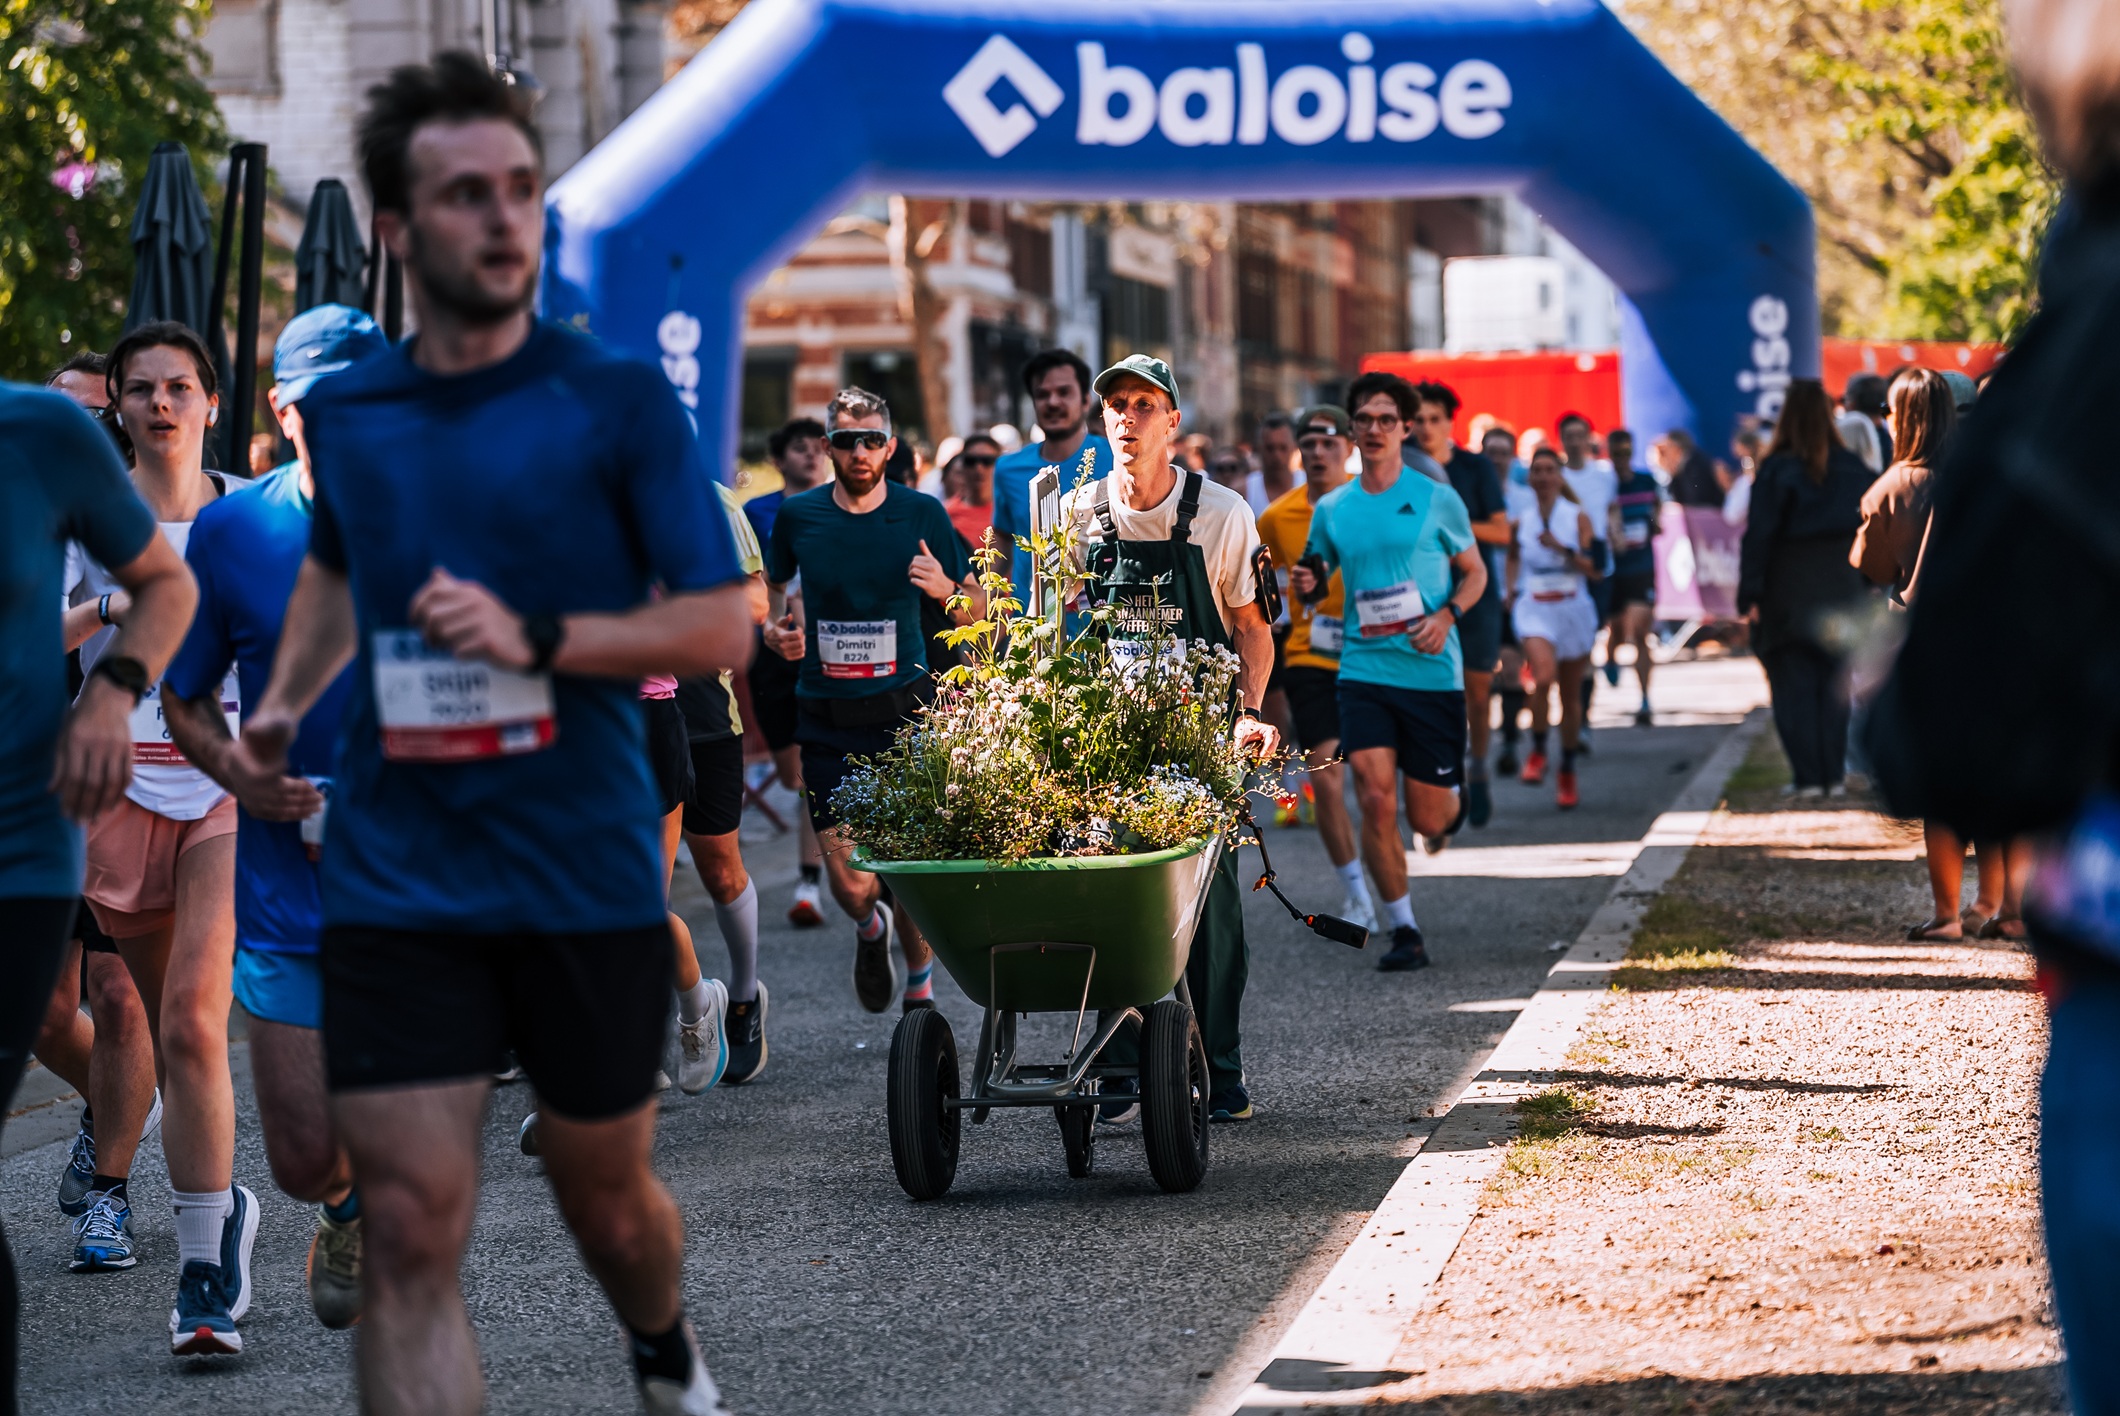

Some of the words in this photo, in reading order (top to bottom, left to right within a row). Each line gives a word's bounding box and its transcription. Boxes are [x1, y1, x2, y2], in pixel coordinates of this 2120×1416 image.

[1075, 31, 1513, 147] baloise
[1134, 595, 1153, 607] HET
[840, 624, 885, 635] baloise
[836, 640, 876, 651] Dimitri
[843, 653, 870, 663] 8226
